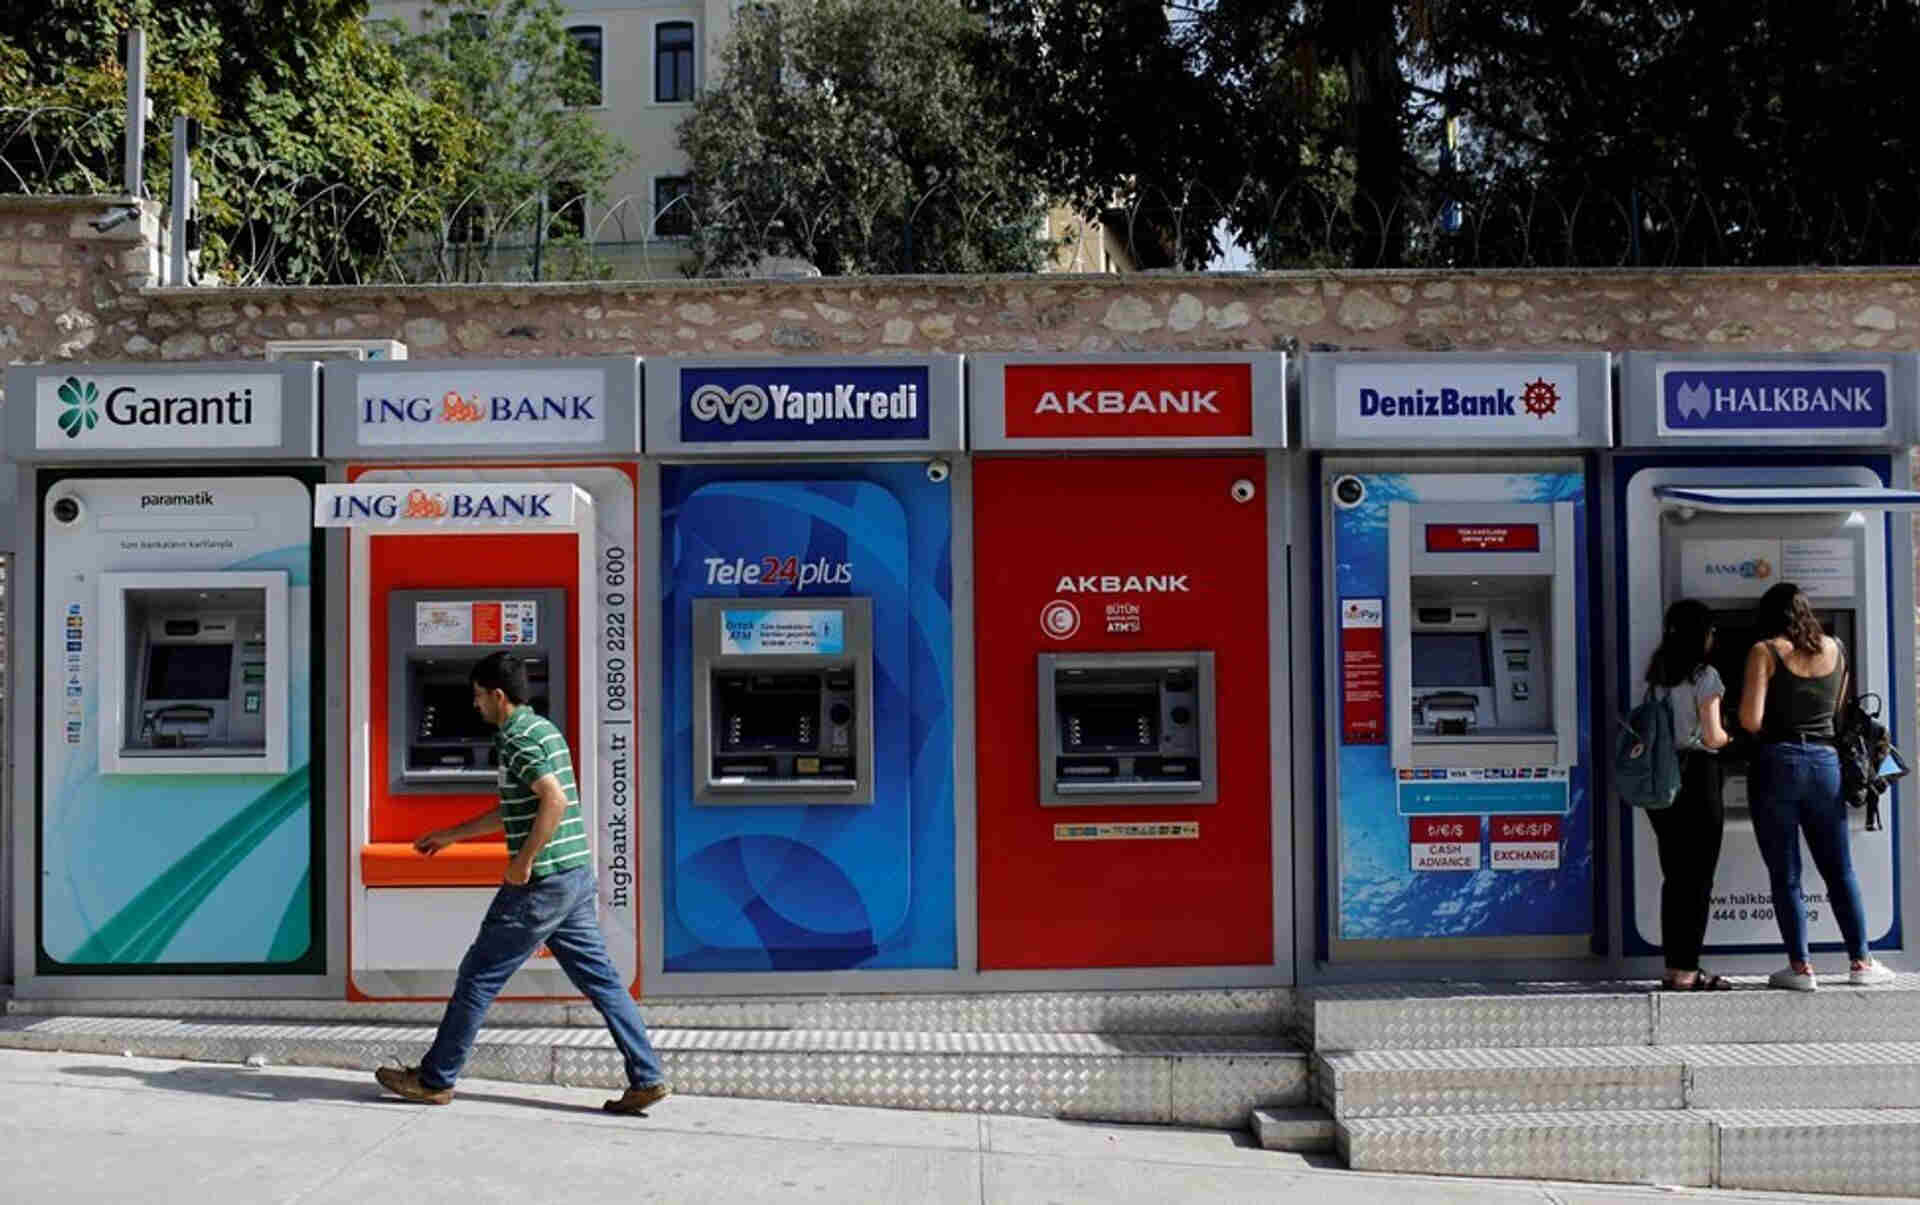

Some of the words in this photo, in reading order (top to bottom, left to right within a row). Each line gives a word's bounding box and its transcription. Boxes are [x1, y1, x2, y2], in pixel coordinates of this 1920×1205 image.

[105, 387, 253, 426] Garanti
[363, 397, 433, 425] ING
[490, 396, 595, 422] BANK
[769, 384, 918, 425] YapıKredi
[1034, 390, 1221, 415] AKBANK
[1360, 387, 1516, 418] DenizBank
[1714, 385, 1873, 412] HALKBANK
[141, 491, 214, 508] paramatik
[332, 496, 398, 519] ING
[452, 494, 552, 518] BANK
[606, 546, 625, 586] 600
[704, 556, 853, 591] Tele24plus
[1056, 575, 1190, 593] AKBANK
[606, 593, 625, 606] 0
[606, 613, 625, 651] 222
[606, 658, 626, 712] 0850
[608, 733, 633, 907] ingbank.com.tr
[1418, 856, 1472, 867] ADVANCE
[1429, 845, 1461, 855] CASH
[1494, 850, 1556, 861] EXCHANGE
[1712, 909, 1735, 920] 444
[1750, 908, 1774, 920] 400
